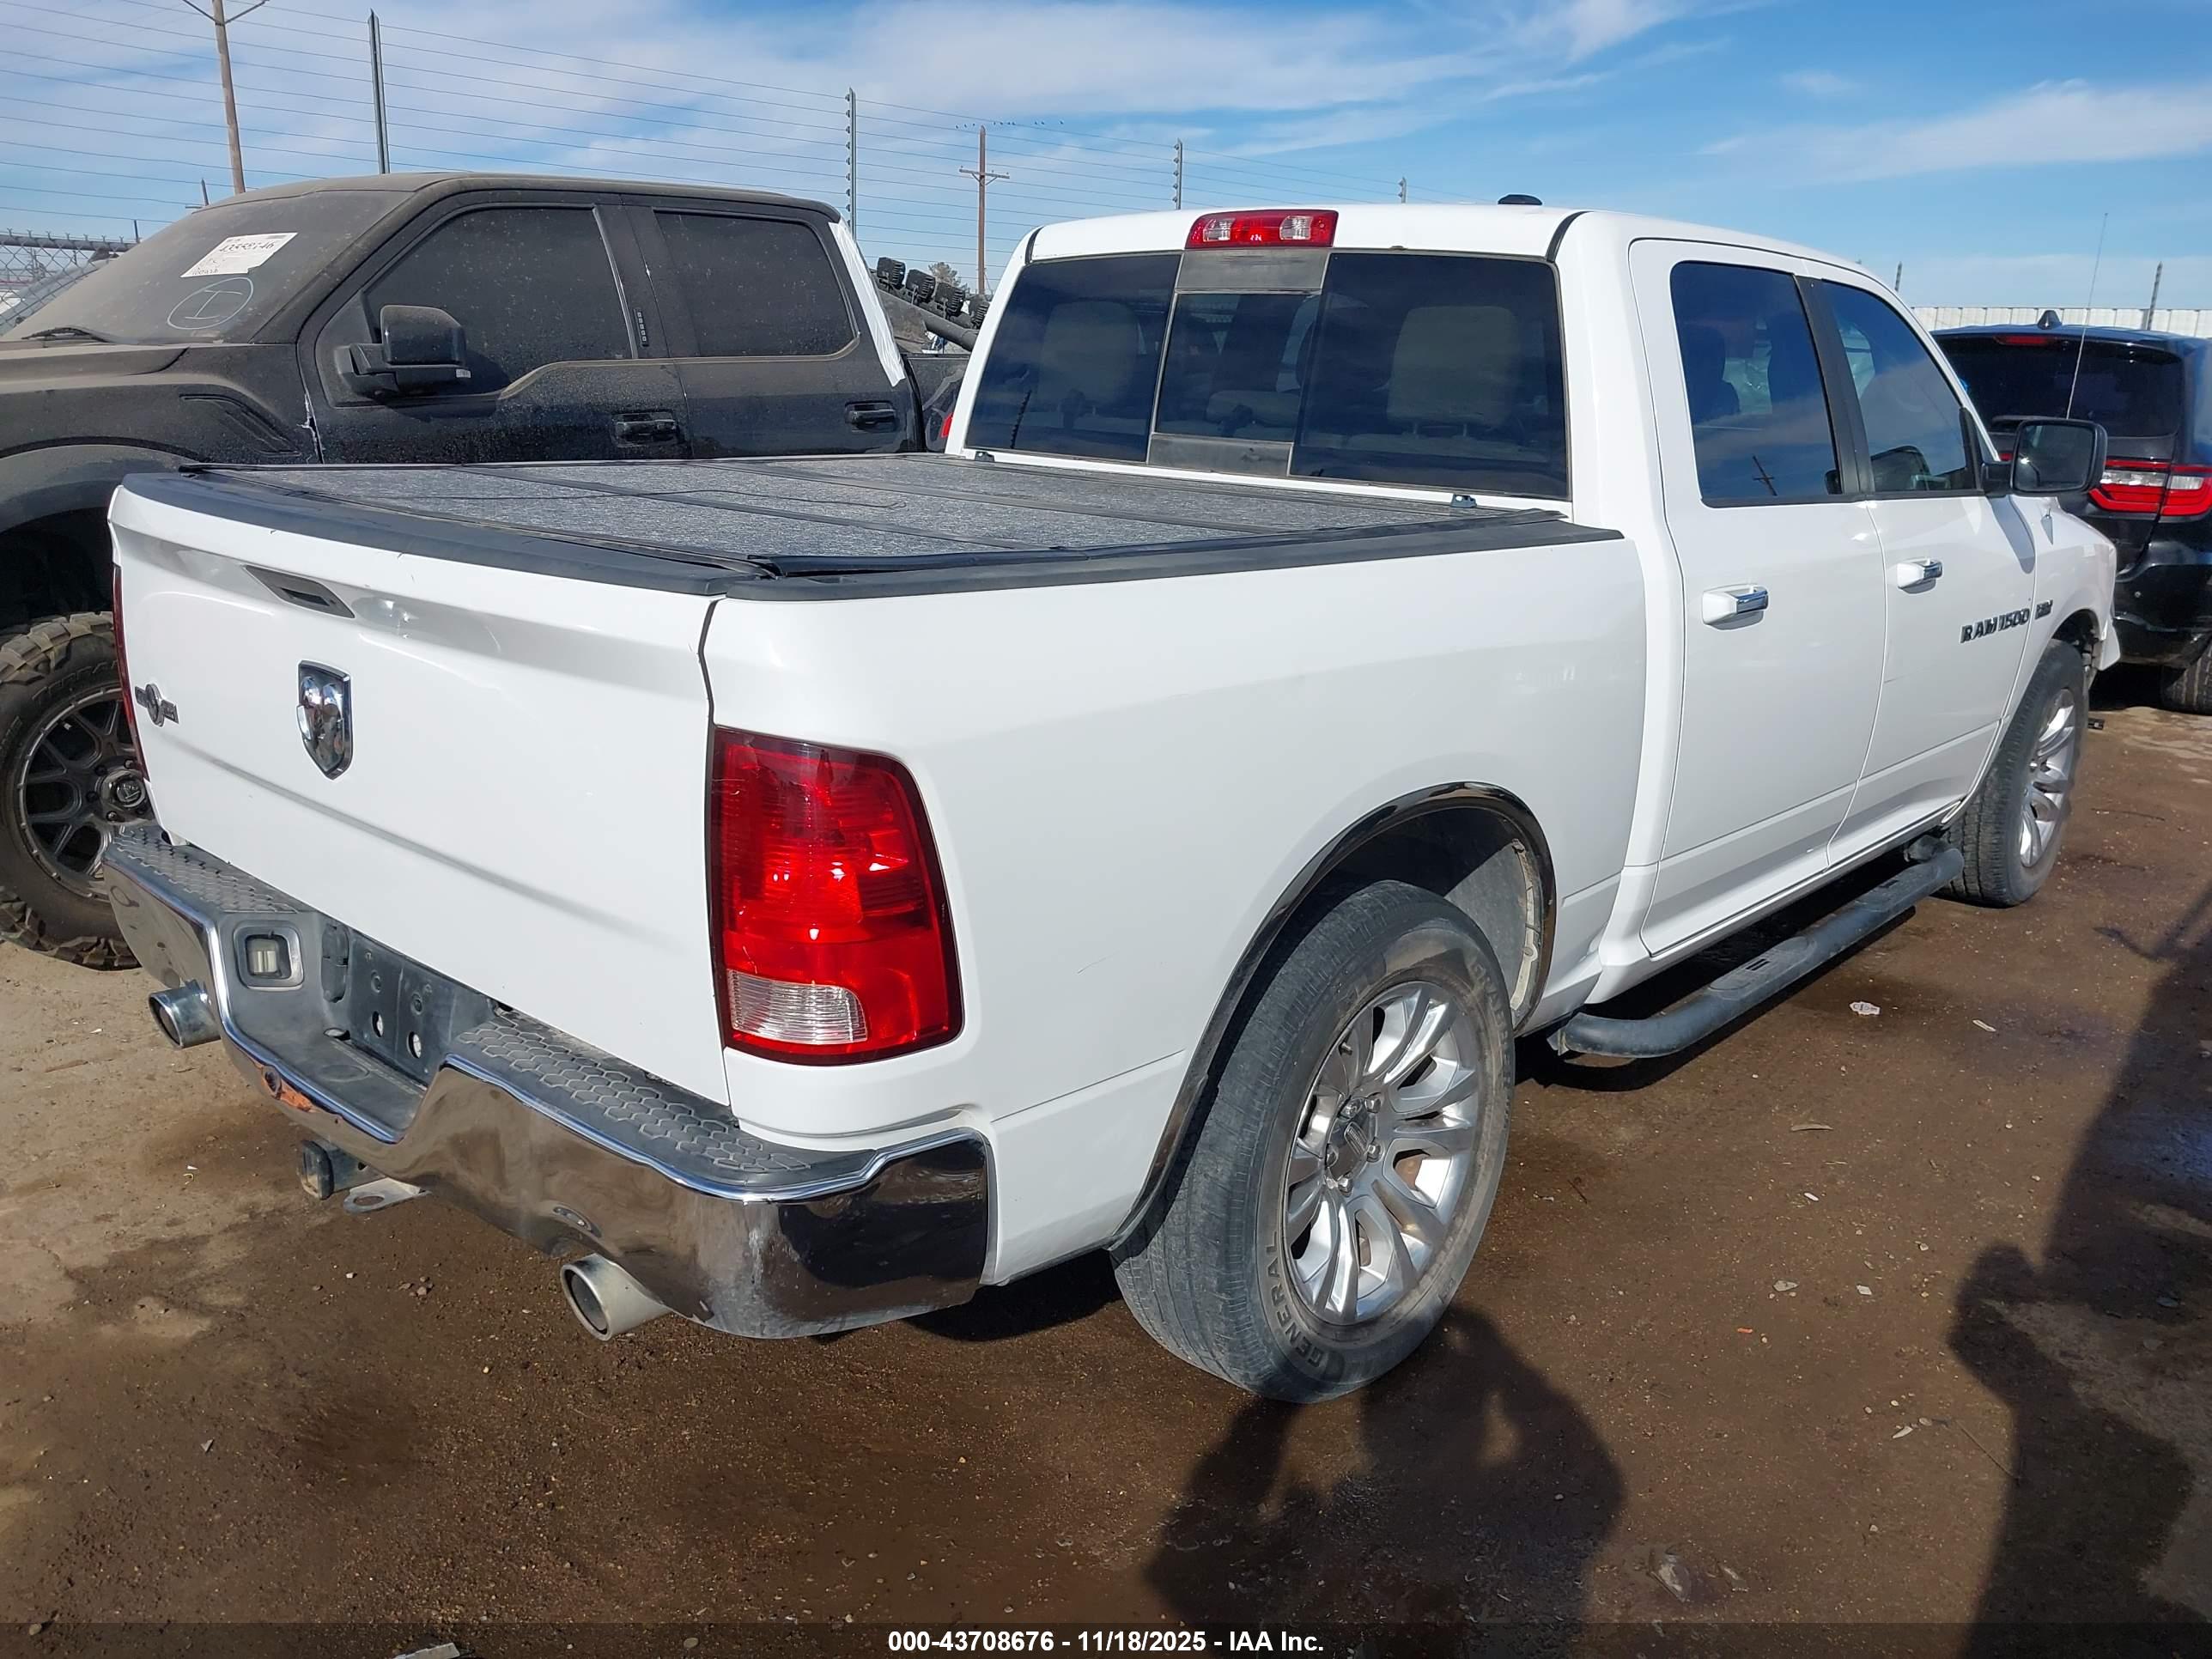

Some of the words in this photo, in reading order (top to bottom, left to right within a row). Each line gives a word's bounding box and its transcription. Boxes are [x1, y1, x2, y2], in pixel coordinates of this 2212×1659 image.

[1960, 617, 1998, 644] RAM
[1998, 608, 2030, 631] 1500
[1266, 1231, 1325, 1367] GENERAL
